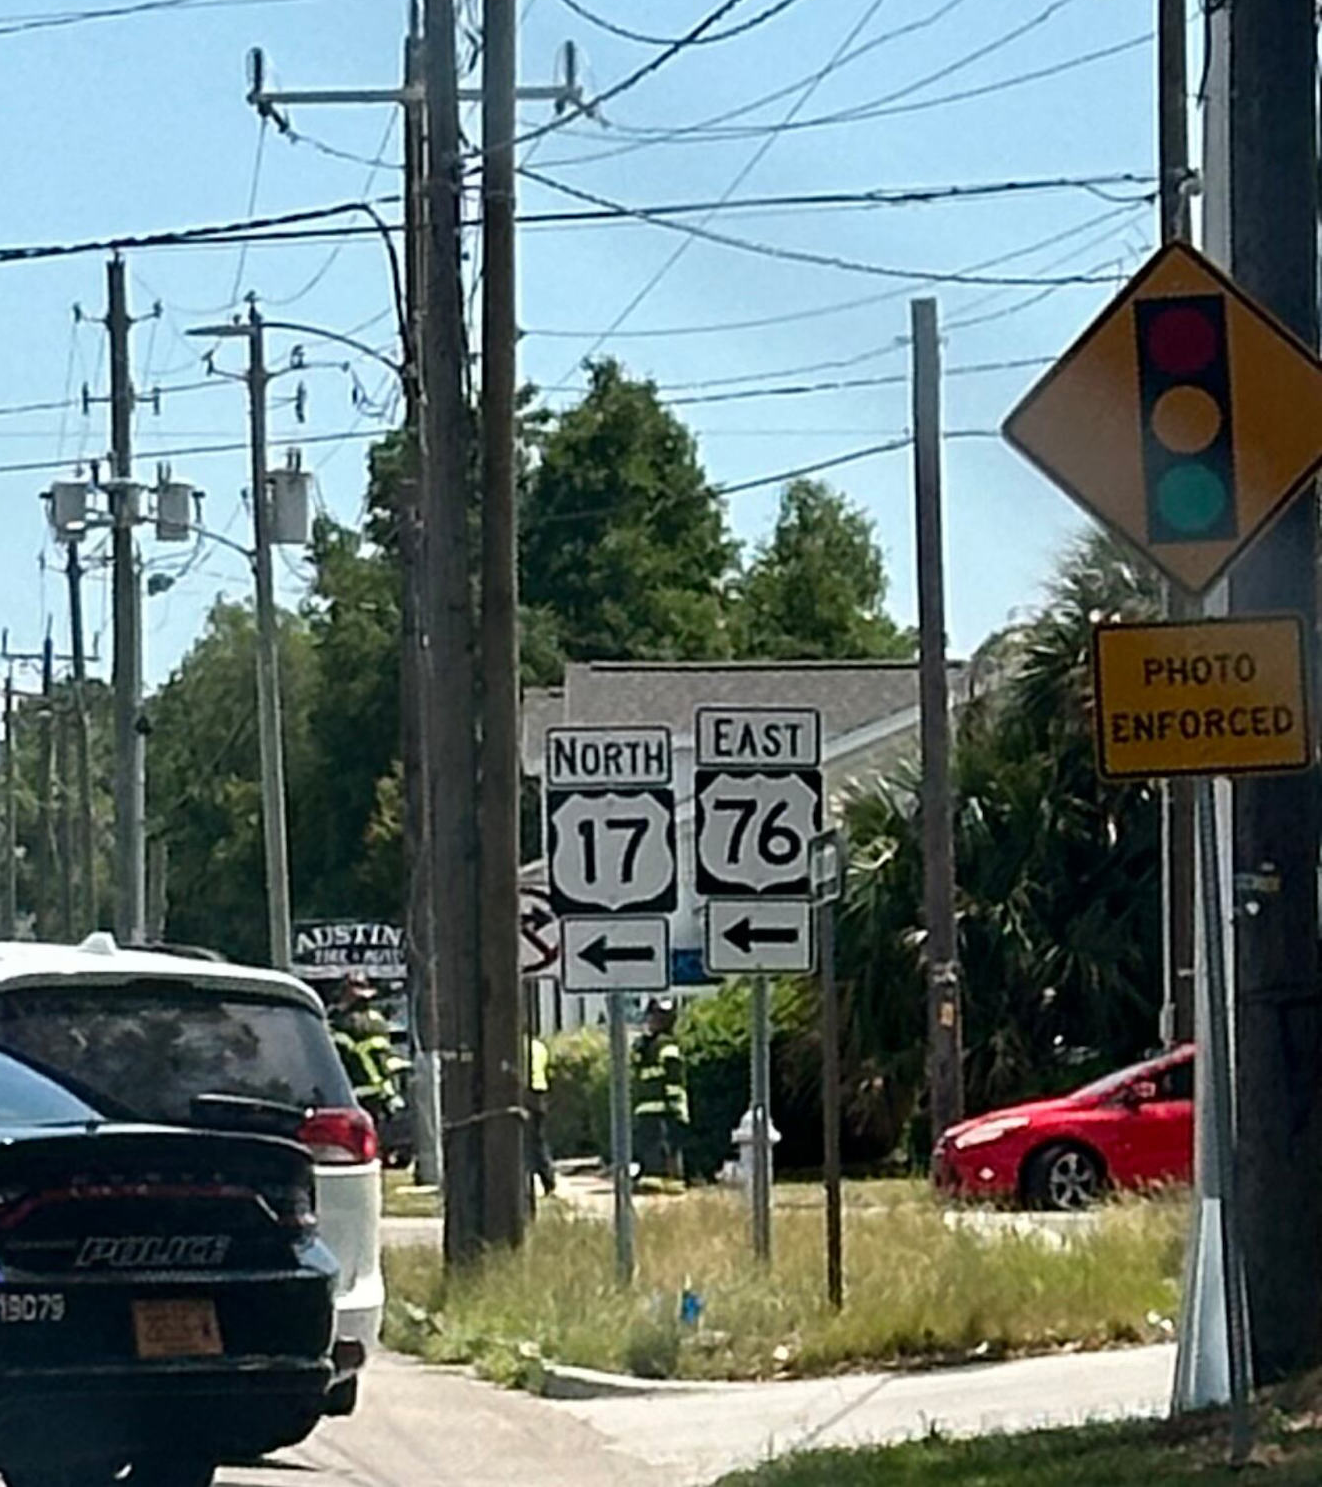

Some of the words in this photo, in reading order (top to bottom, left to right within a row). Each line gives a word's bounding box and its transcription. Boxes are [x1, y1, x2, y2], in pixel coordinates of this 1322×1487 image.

[1143, 653, 1256, 687] PHOTO
[713, 718, 803, 758] EAST
[1111, 705, 1294, 744] ENFORCED
[554, 736, 664, 777] NORTH
[577, 818, 650, 884] 17
[712, 798, 802, 866] 76
